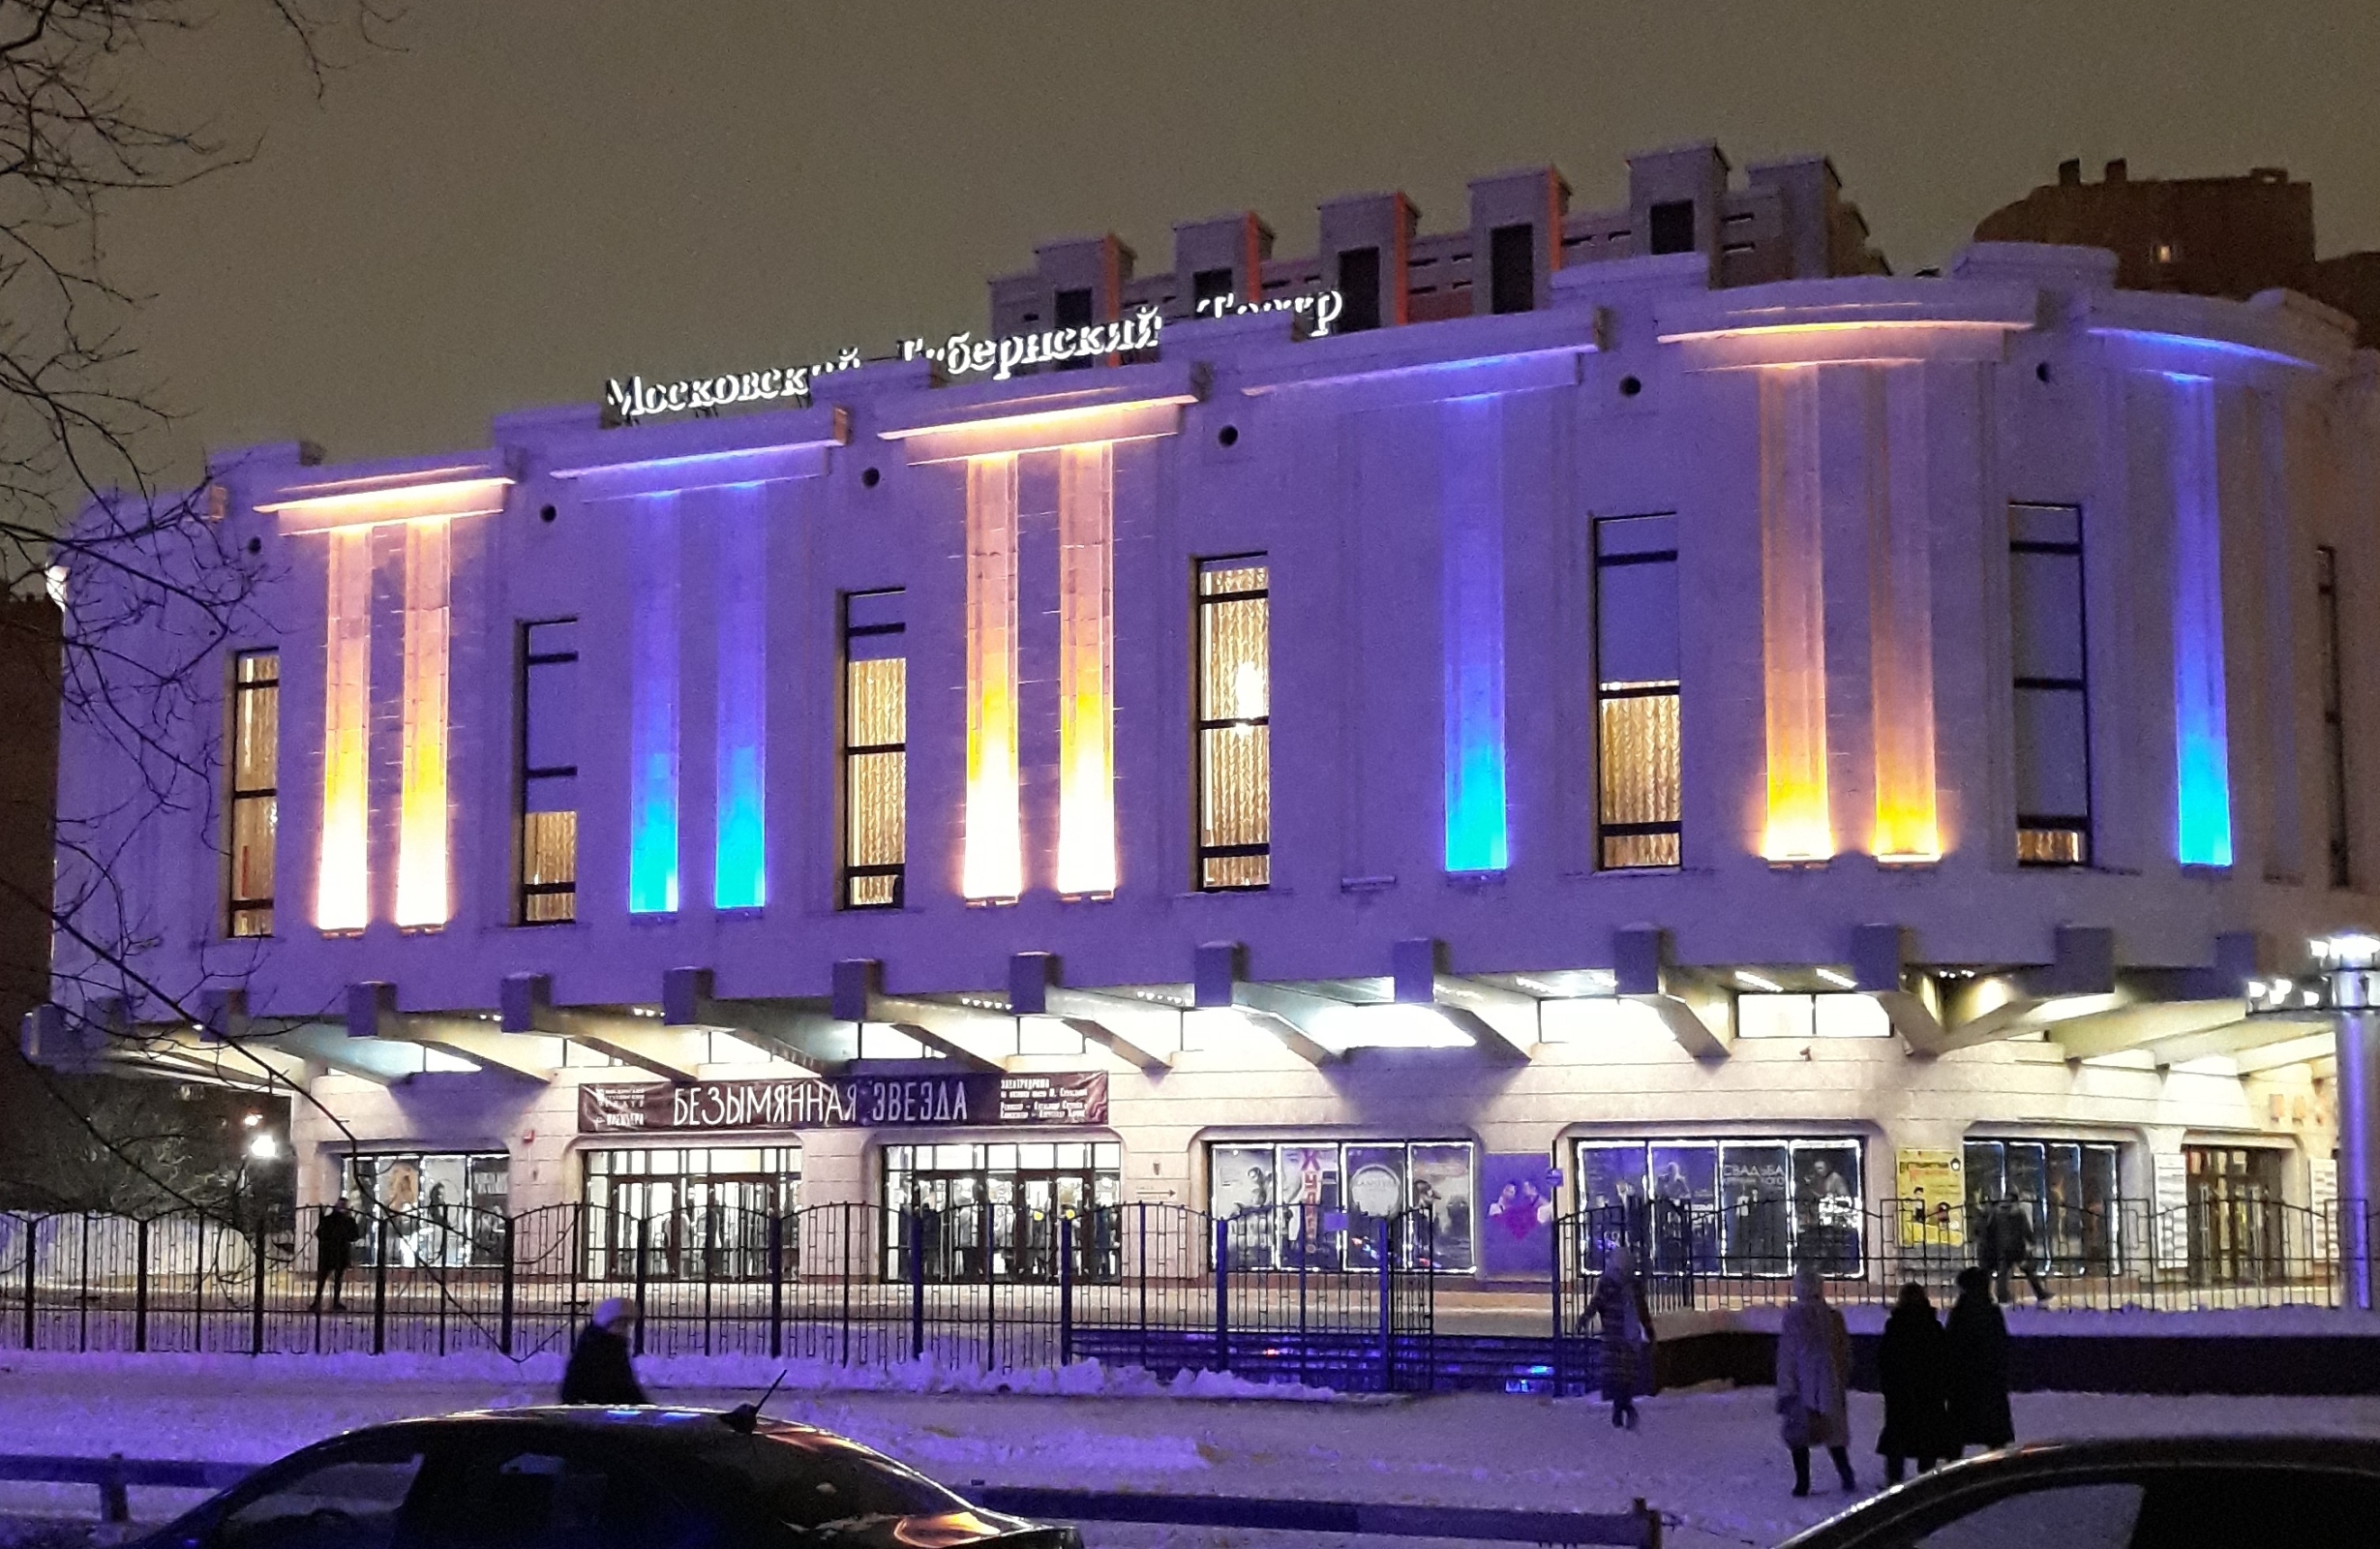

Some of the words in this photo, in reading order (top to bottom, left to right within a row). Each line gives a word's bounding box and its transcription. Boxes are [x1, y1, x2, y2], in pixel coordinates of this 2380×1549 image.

[673, 1083, 858, 1126] БЕЗЫМЯННАЯ
[872, 1080, 969, 1122] ЗВЕЗДА
[1723, 1164, 1786, 1177] СВАДБА
